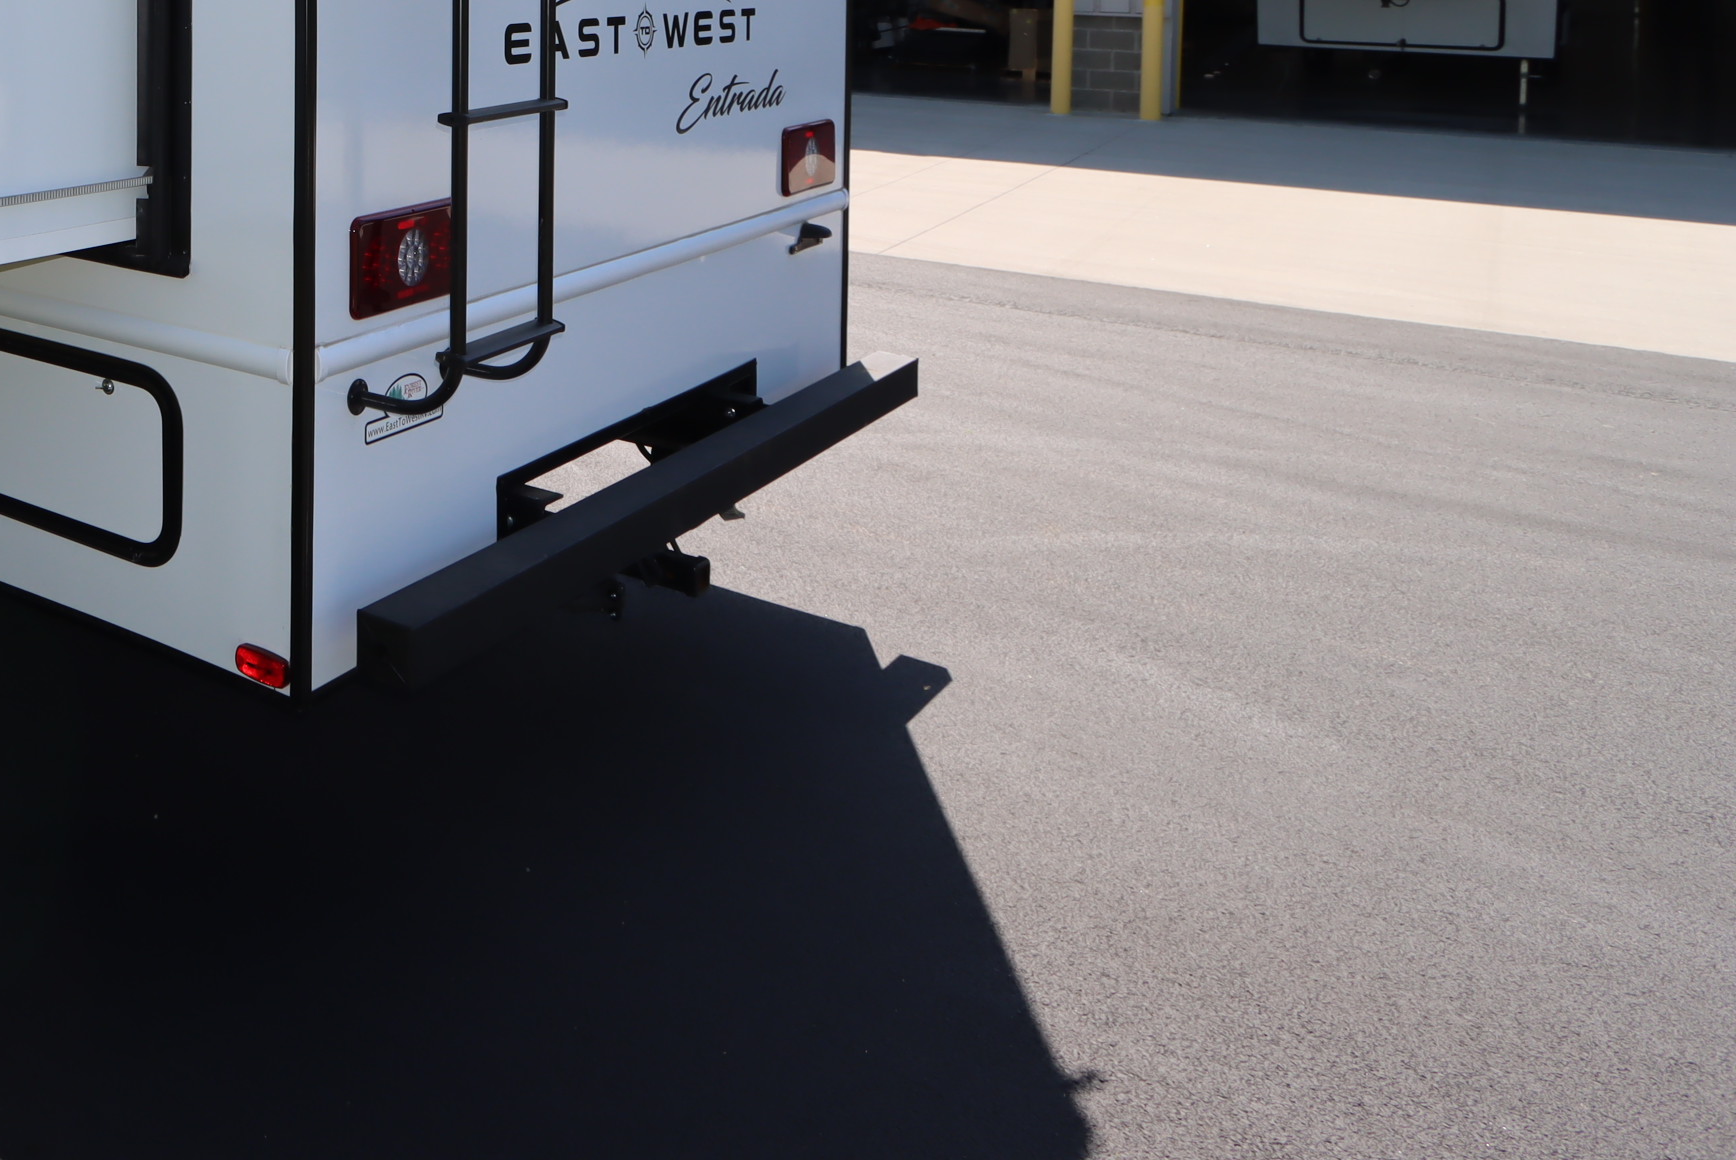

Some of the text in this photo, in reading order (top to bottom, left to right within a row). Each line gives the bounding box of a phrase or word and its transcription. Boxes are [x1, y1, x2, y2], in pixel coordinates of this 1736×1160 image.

[504, 16, 626, 65] EAST
[663, 8, 756, 49] WEST
[676, 68, 786, 134] Entrada
